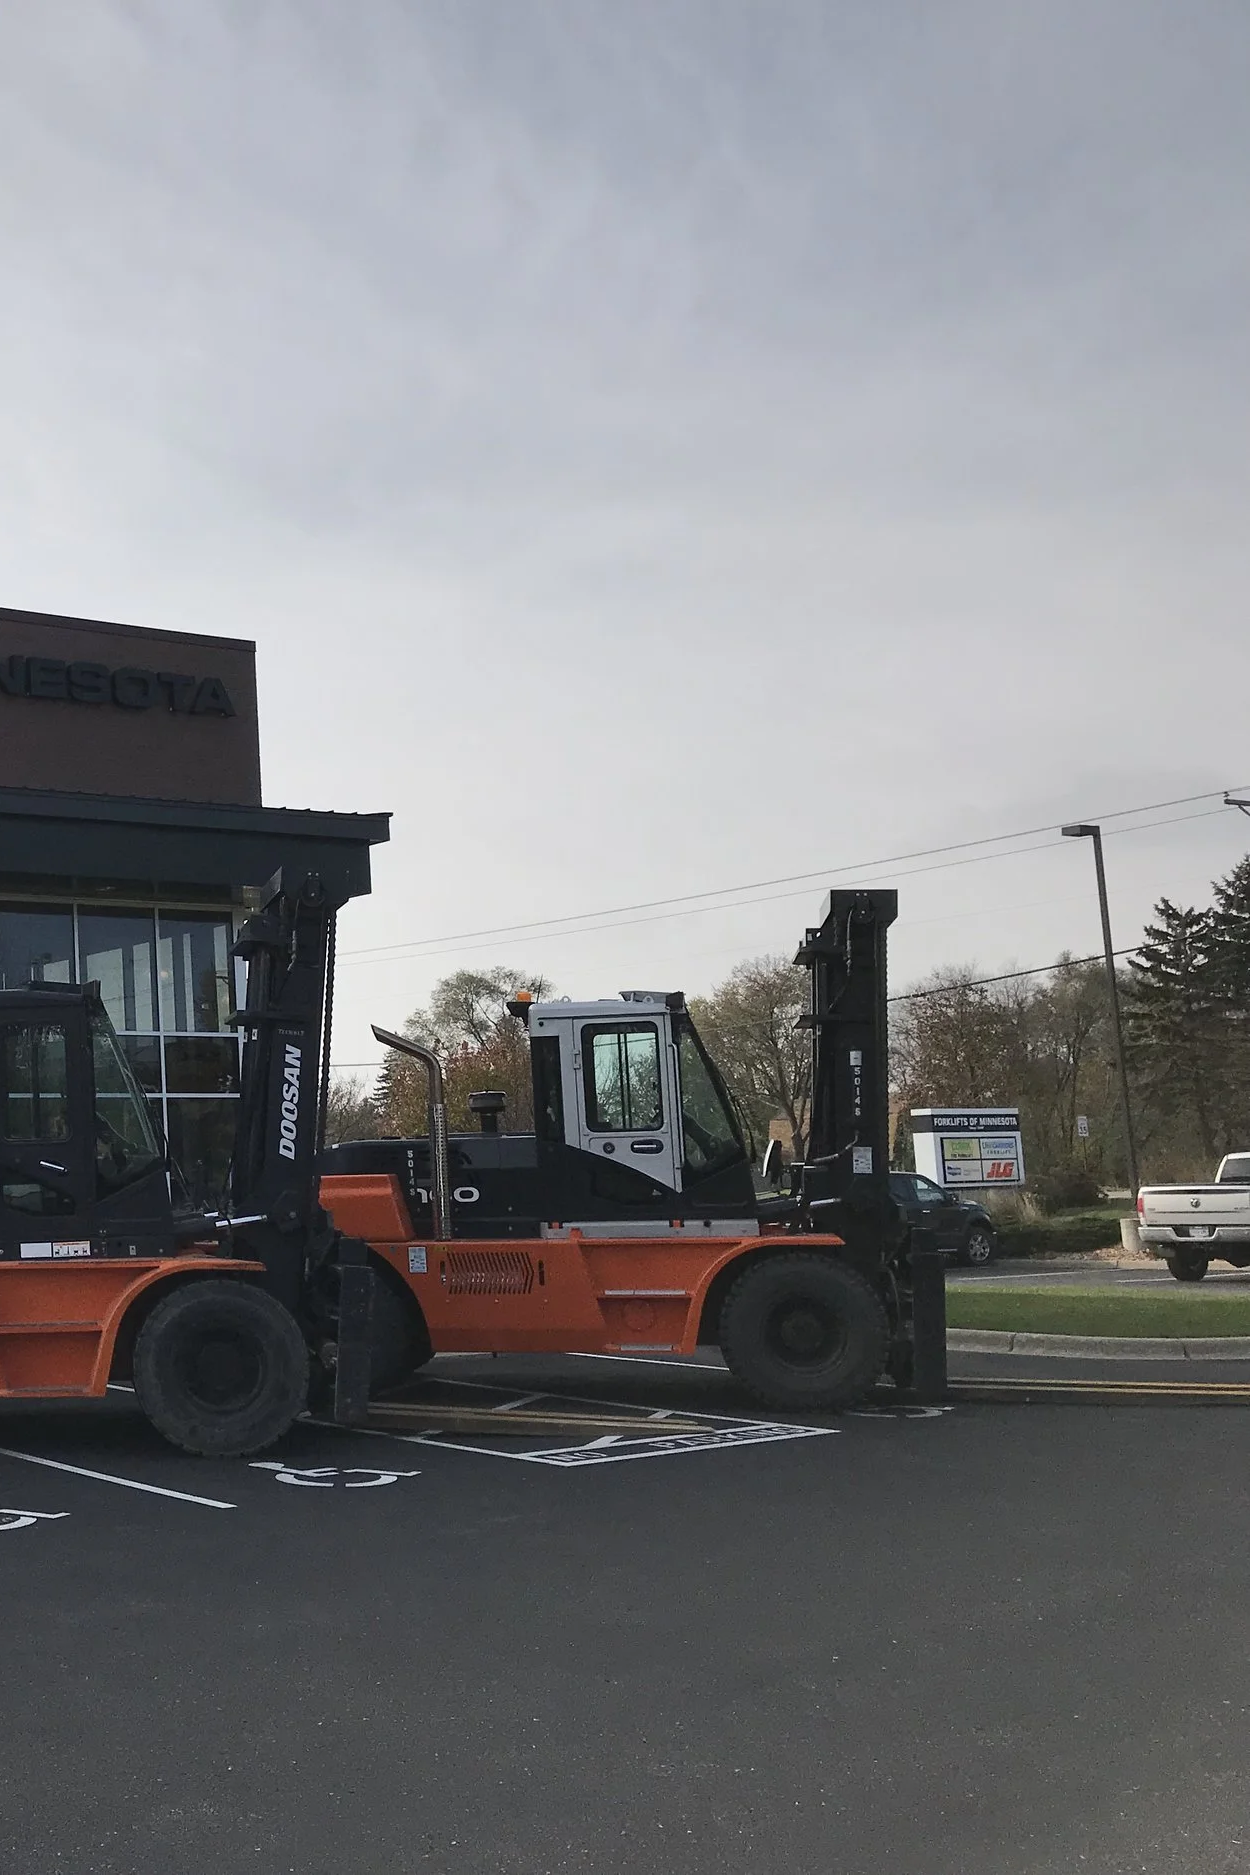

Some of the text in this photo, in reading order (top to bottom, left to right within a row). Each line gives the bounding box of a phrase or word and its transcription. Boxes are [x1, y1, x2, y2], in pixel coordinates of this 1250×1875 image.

[279, 1043, 302, 1160] DOOSAN
[934, 1116, 1018, 1127] FORKLIFTS OF MINNESOTA
[986, 1161, 1015, 1179] JLG
[648, 1427, 806, 1449] PARKING
